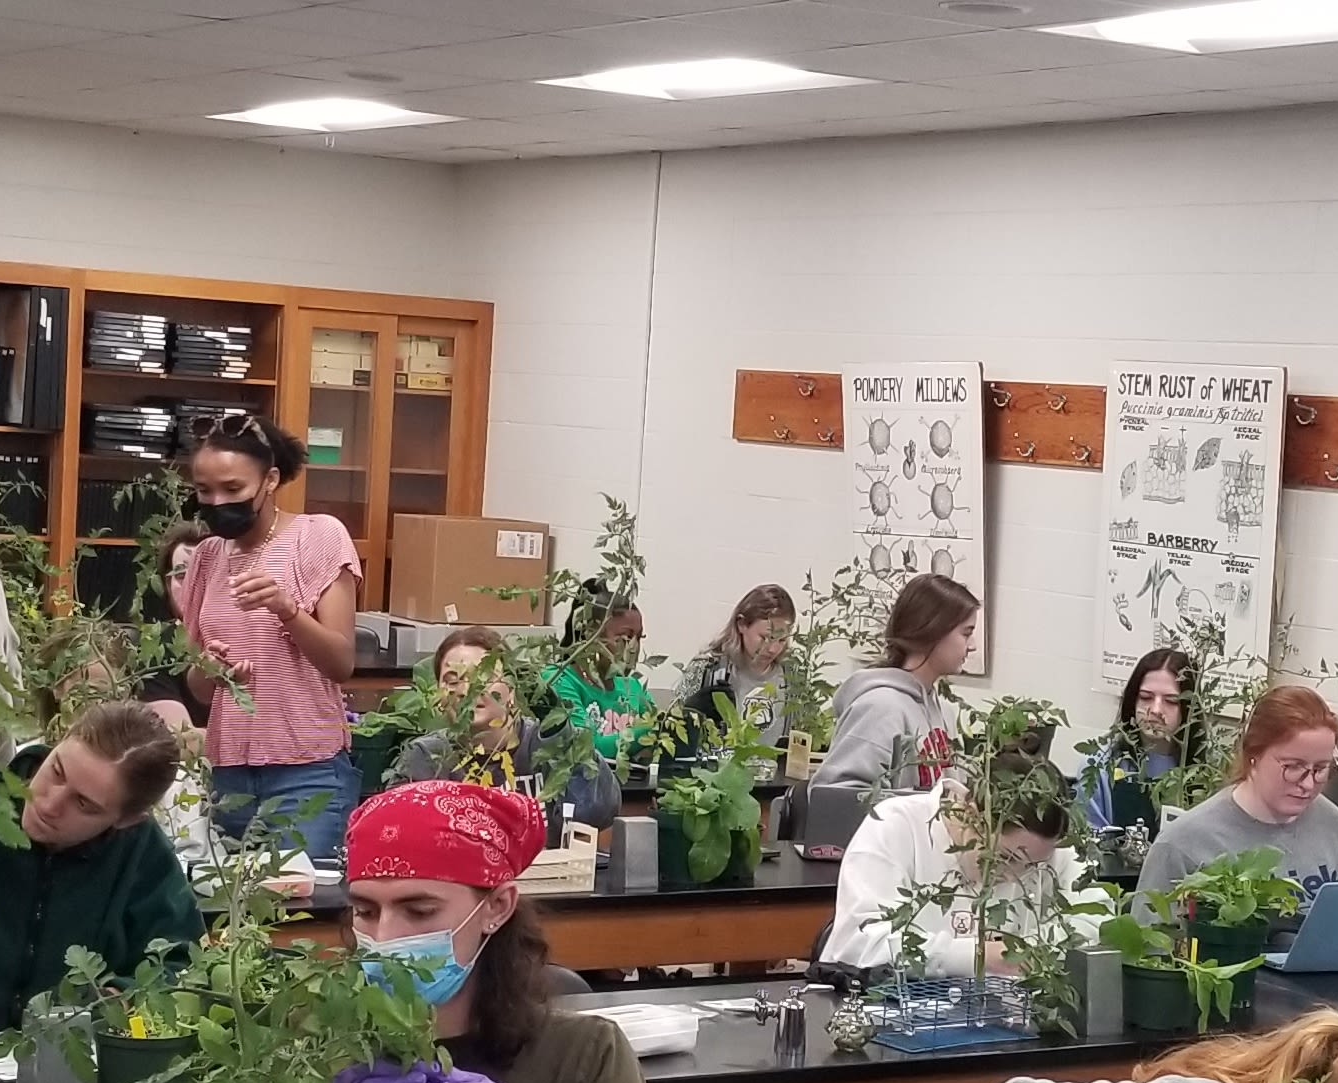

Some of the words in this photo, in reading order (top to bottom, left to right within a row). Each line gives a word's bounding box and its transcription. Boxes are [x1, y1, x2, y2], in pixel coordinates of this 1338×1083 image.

[853, 377, 903, 402] POWDERY
[915, 377, 967, 403] MILDEWS
[1118, 373, 1152, 396] STEM
[1159, 375, 1195, 399] RUST
[1200, 377, 1217, 400] of
[1222, 377, 1272, 403] WHEAT
[1119, 400, 1163, 415] Puccinia
[1147, 532, 1218, 552] BARBERRY
